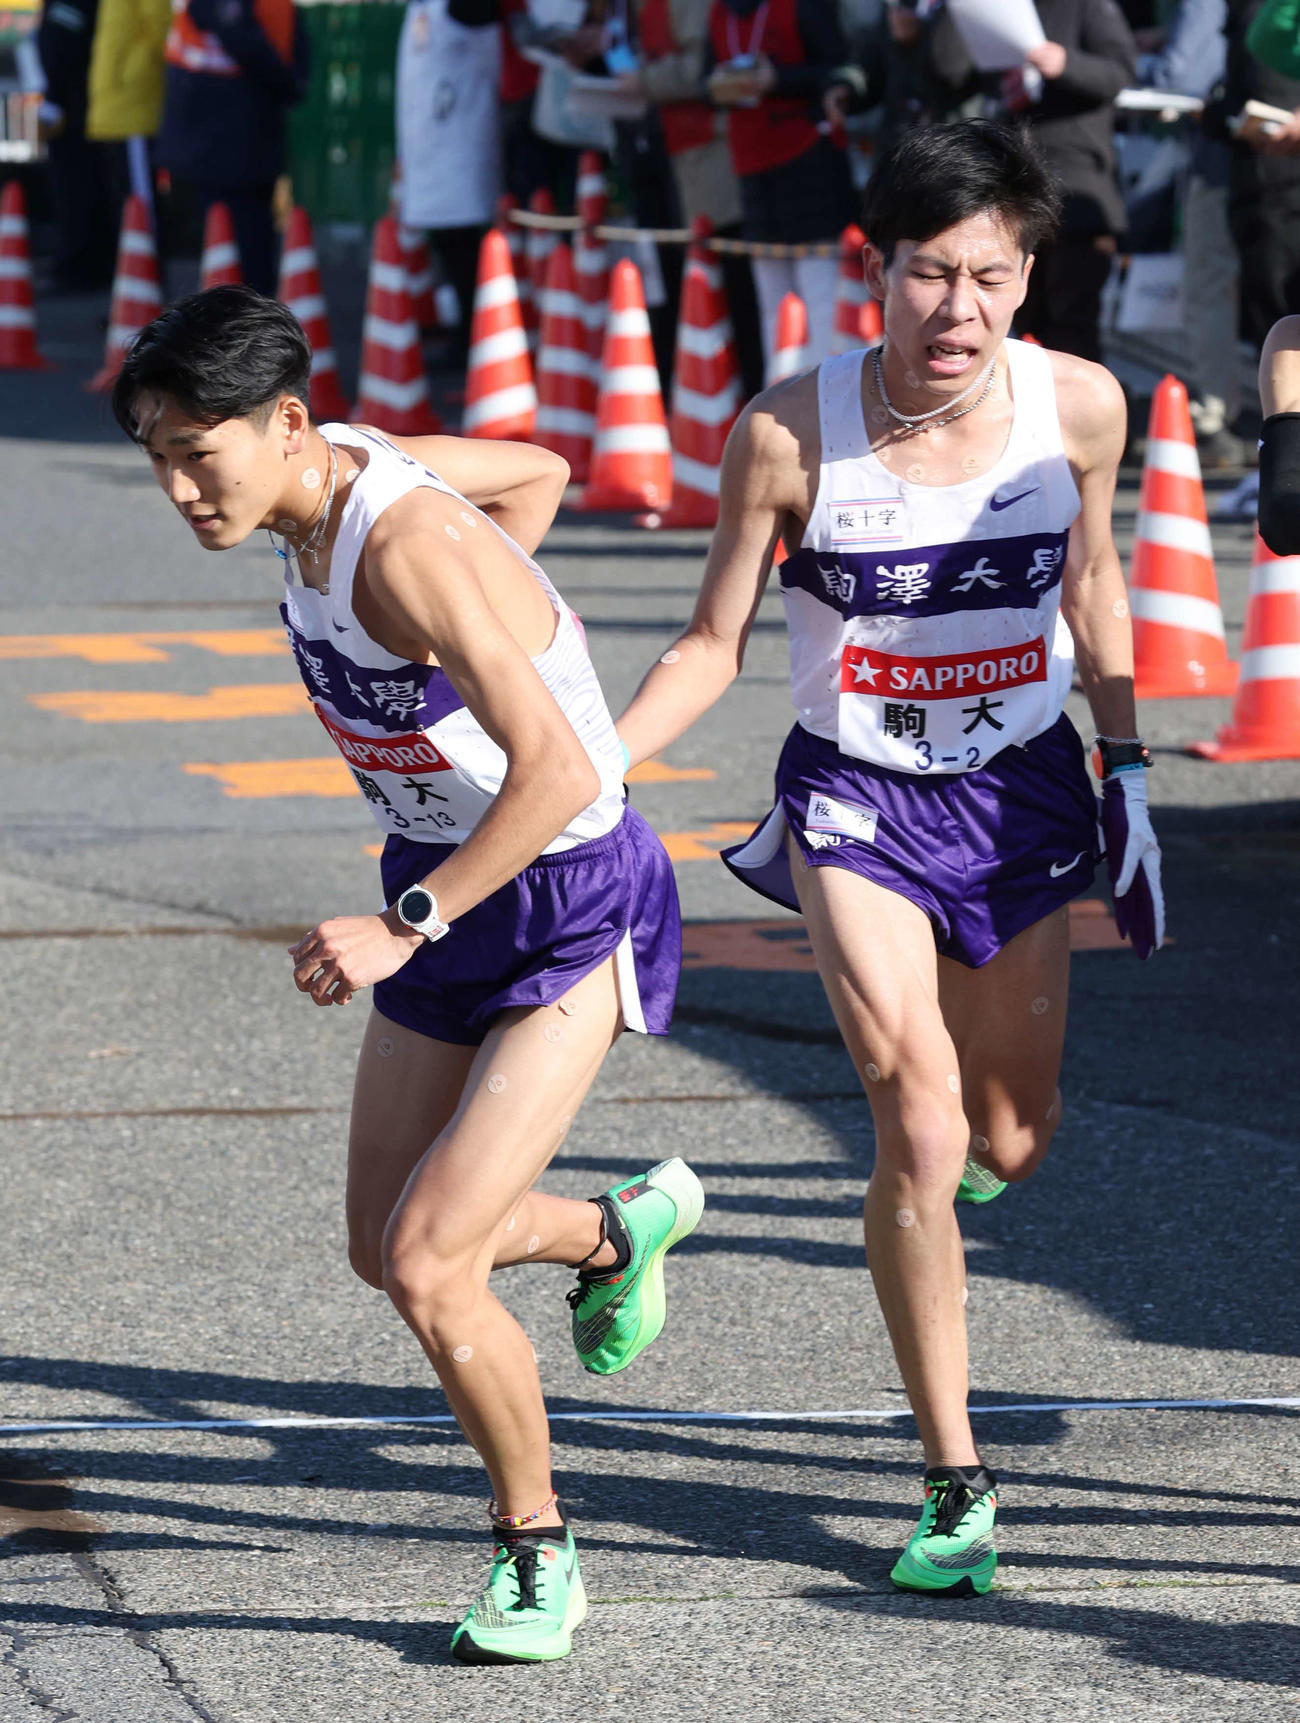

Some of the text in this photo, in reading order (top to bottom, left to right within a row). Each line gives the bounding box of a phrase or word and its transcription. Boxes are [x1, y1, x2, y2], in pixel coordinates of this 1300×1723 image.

[836, 508, 896, 528] 桜十字
[889, 651, 1039, 691] SAPPORO
[884, 697, 1005, 739] 駒大
[915, 741, 981, 770] 3-2
[385, 807, 456, 829] 3-13
